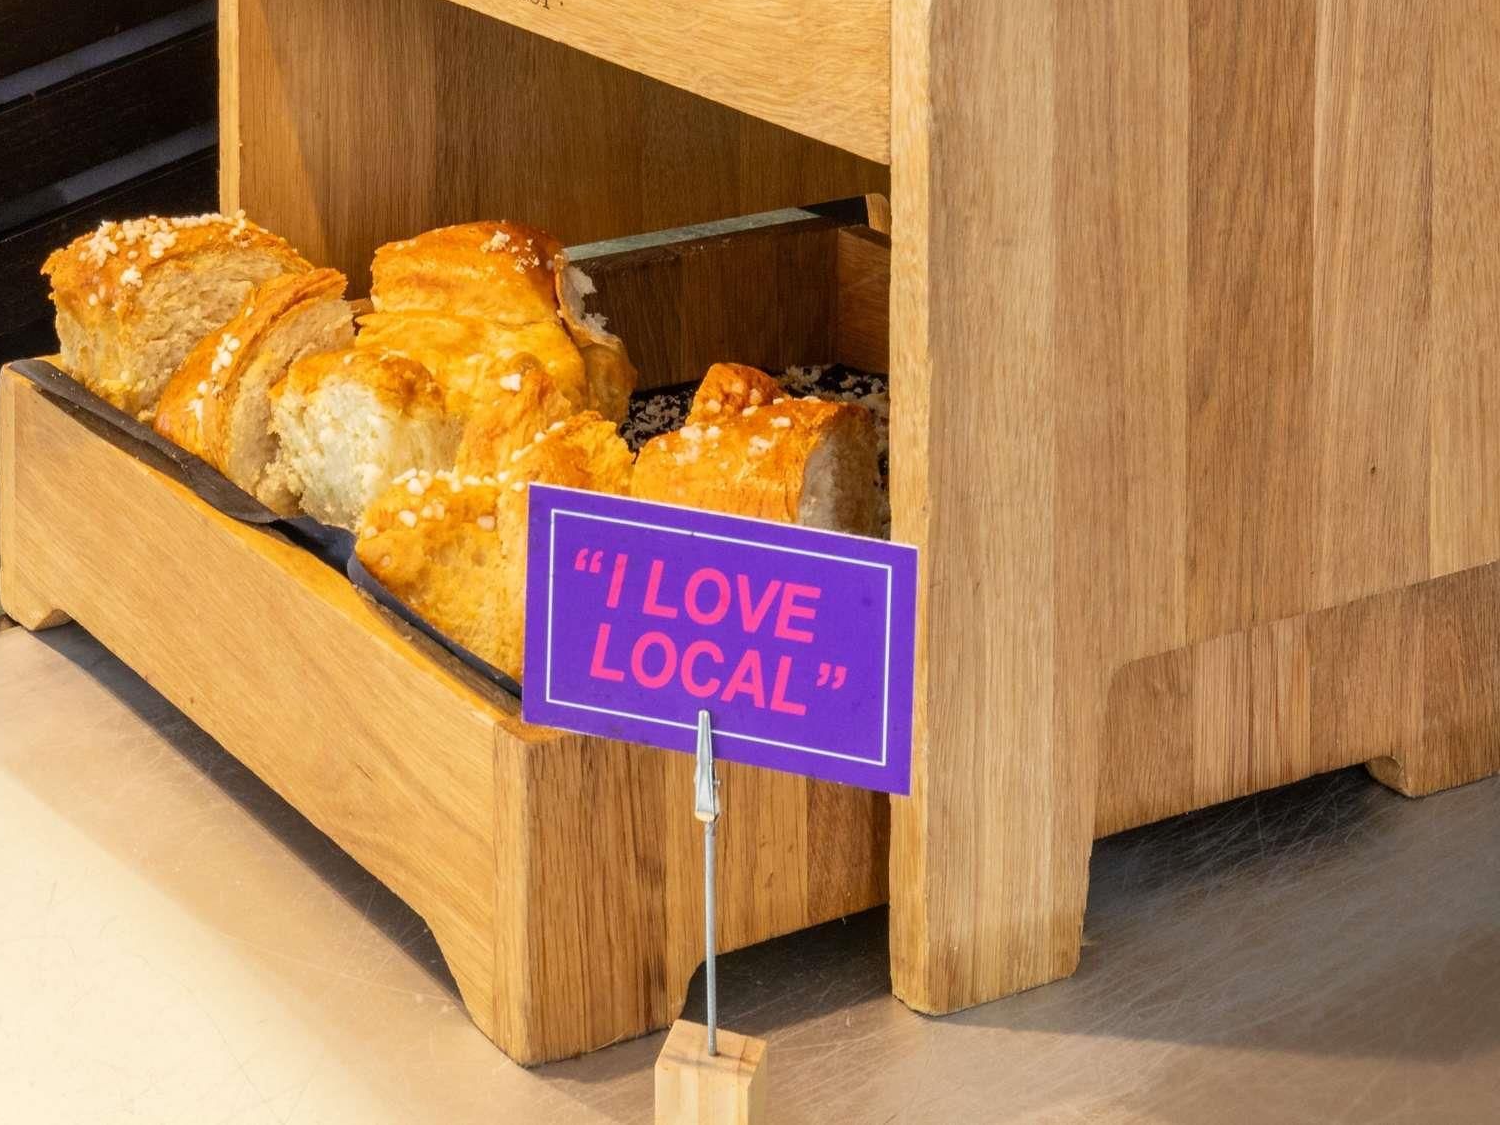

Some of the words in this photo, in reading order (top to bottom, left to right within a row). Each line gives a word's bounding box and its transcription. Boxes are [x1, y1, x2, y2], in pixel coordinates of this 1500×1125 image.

[574, 547, 628, 609] “I
[643, 559, 822, 644] LOVE
[589, 623, 848, 716] LOCAL”
